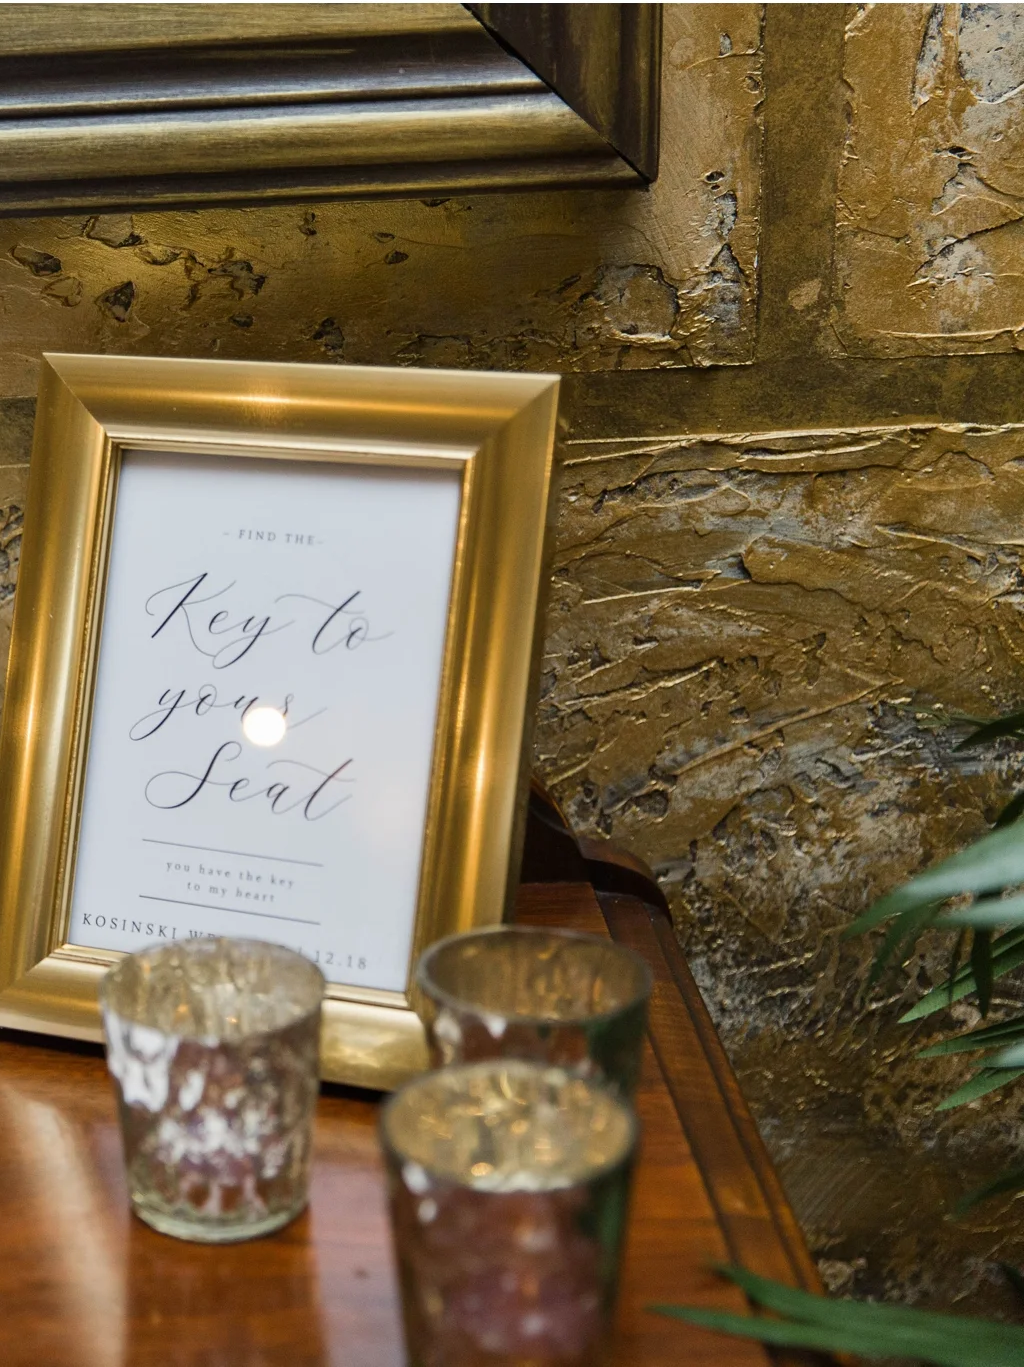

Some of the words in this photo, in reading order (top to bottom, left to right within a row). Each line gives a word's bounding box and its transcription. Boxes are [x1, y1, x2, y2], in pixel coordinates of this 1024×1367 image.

[238, 528, 277, 542] FIND
[285, 532, 316, 546] THE
[145, 572, 296, 670] Key
[274, 590, 395, 656] to
[144, 740, 357, 822] Seat
[166, 861, 191, 873] you
[198, 863, 231, 879] have
[239, 869, 263, 883] the
[270, 874, 295, 890] key
[187, 881, 201, 892] to
[209, 884, 228, 898] my
[235, 886, 277, 903] heart
[82, 912, 178, 941] KOSINSKI
